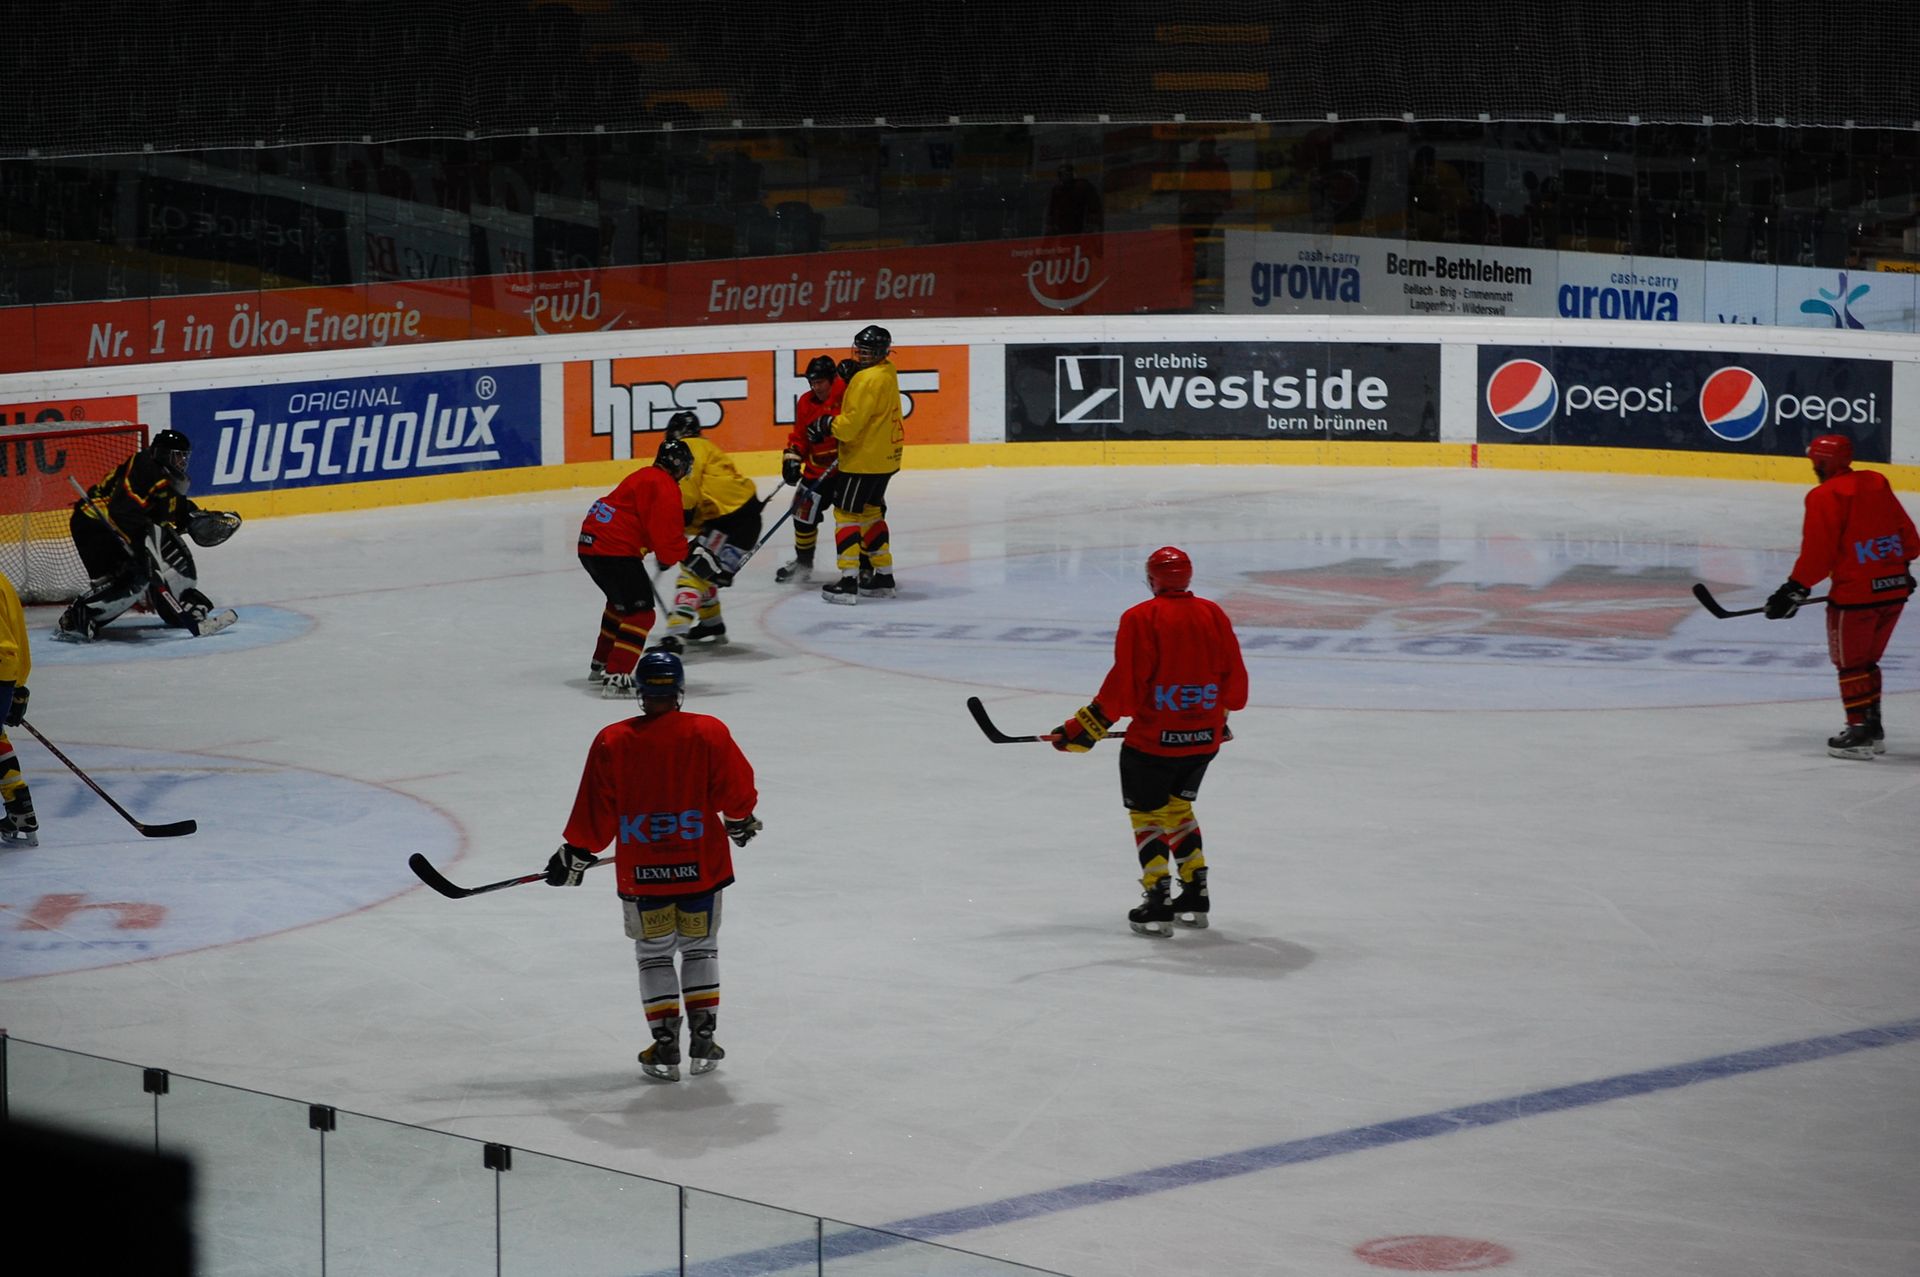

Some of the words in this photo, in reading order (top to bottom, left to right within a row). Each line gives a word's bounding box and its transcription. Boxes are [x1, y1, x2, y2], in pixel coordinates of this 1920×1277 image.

[1021, 245, 1090, 294] ewb
[1251, 261, 1360, 307] growa
[1387, 253, 1532, 285] Bern-Bethlehem
[523, 279, 602, 328] ewb
[708, 273, 813, 318] Energie
[820, 269, 866, 314] für
[875, 267, 936, 301] Bern
[1558, 283, 1678, 321] growa
[87, 322, 134, 362] Nr.
[150, 319, 166, 354] 1
[183, 314, 214, 352] in
[228, 300, 421, 350] Öko-Energie
[1134, 353, 1209, 370] erlebnis
[288, 386, 402, 414] ORIGINAL
[1136, 368, 1389, 410] westside
[1565, 381, 1673, 419] pepsi
[1267, 414, 1308, 431] bern
[1313, 414, 1388, 432] brünnen
[1774, 392, 1878, 429] pepsi
[1154, 682, 1220, 711] KPS
[1161, 729, 1214, 744] LEXMARK
[619, 809, 705, 845] KPS
[636, 864, 699, 880] LEXMARK
